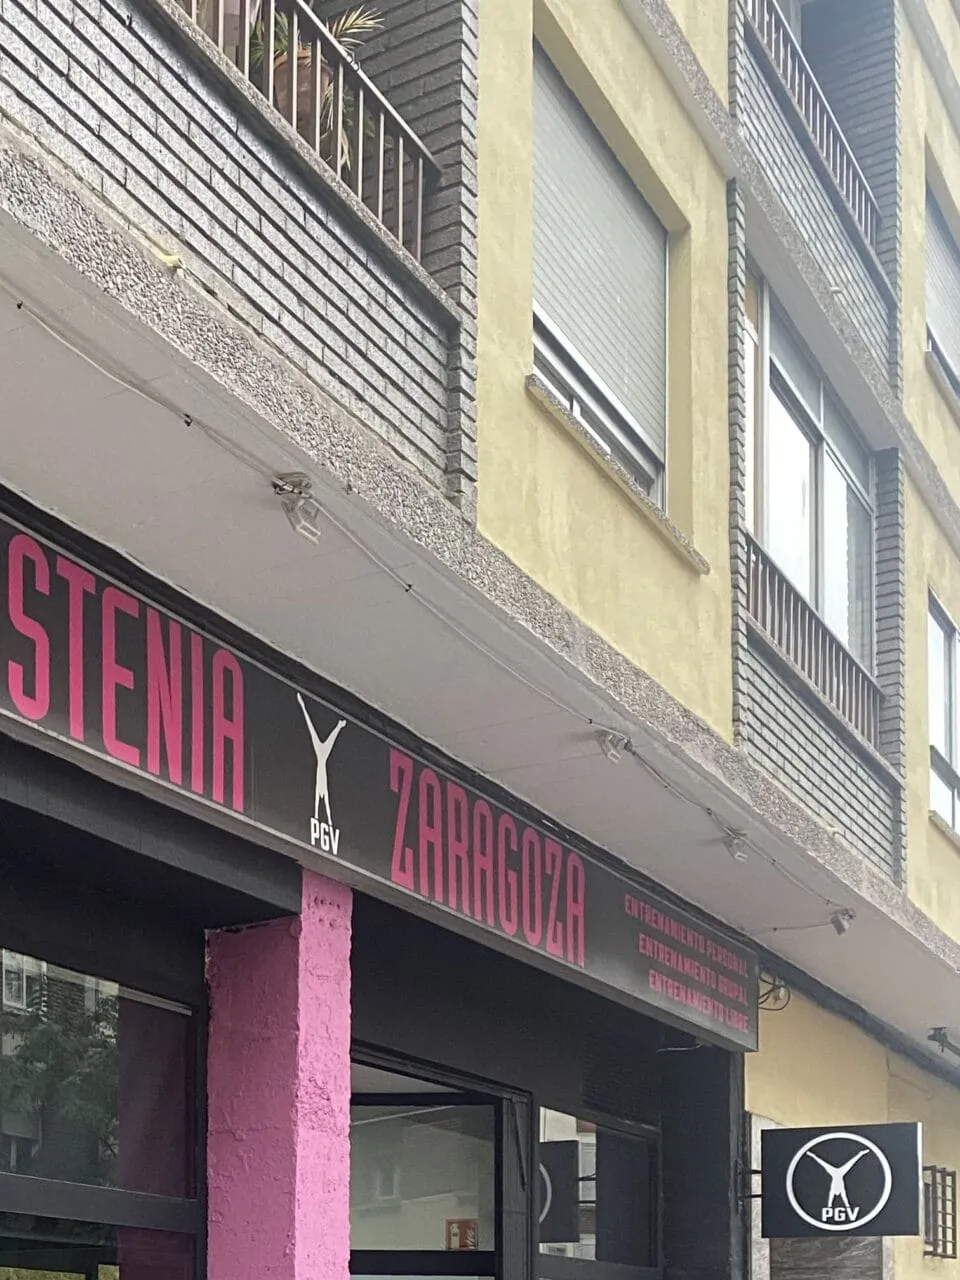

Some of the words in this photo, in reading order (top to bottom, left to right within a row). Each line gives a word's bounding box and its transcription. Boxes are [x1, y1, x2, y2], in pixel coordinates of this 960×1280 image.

[310, 816, 340, 856] PGV
[389, 748, 586, 969] ZARAGOZA
[624, 893, 705, 954] ENTRENAMIENTO
[638, 932, 717, 990] ENTRENAMIENTO
[648, 968, 724, 1023] ENTRENAMIENTO
[821, 1206, 860, 1222] PGV
